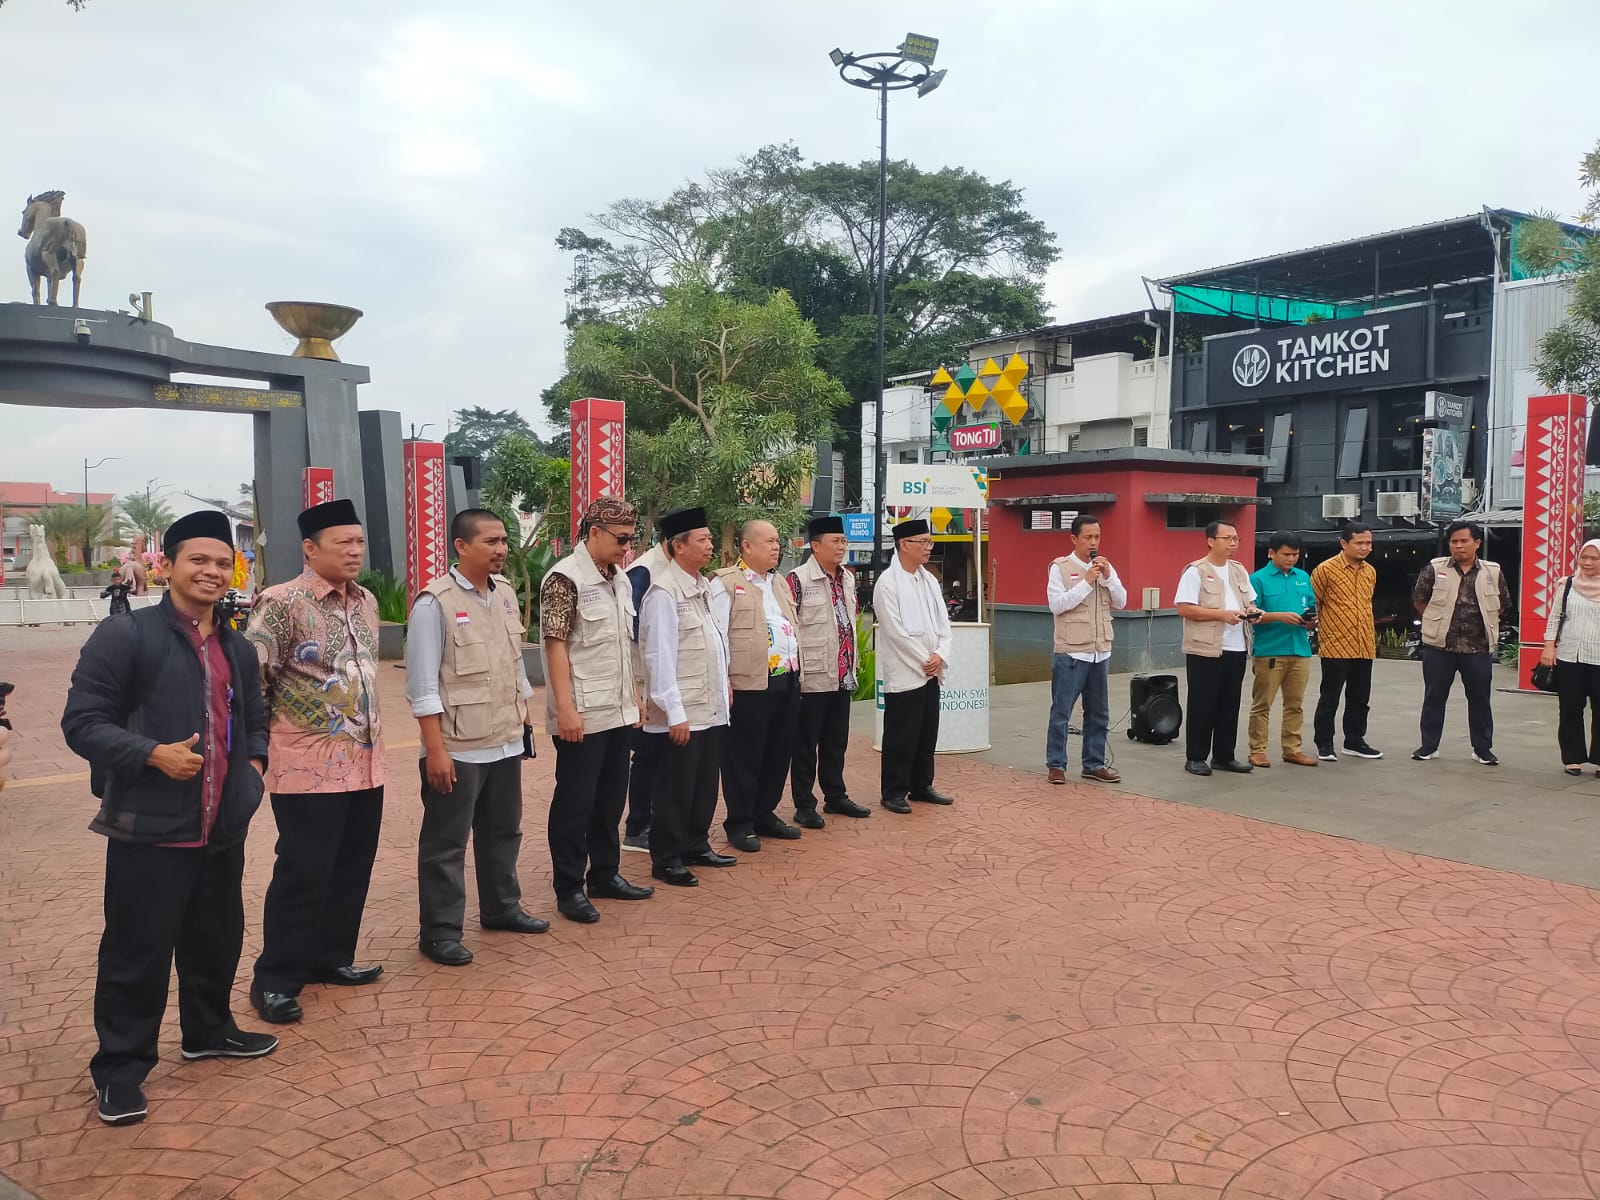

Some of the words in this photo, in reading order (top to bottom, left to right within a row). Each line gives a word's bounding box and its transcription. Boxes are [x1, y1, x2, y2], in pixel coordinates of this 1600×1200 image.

[1277, 324, 1389, 360] TAMKOT
[1276, 349, 1389, 383] KITCHEN
[953, 431, 982, 447] TONG
[982, 427, 996, 444] TJI
[903, 481, 926, 494] BSI
[939, 689, 968, 700] BANK
